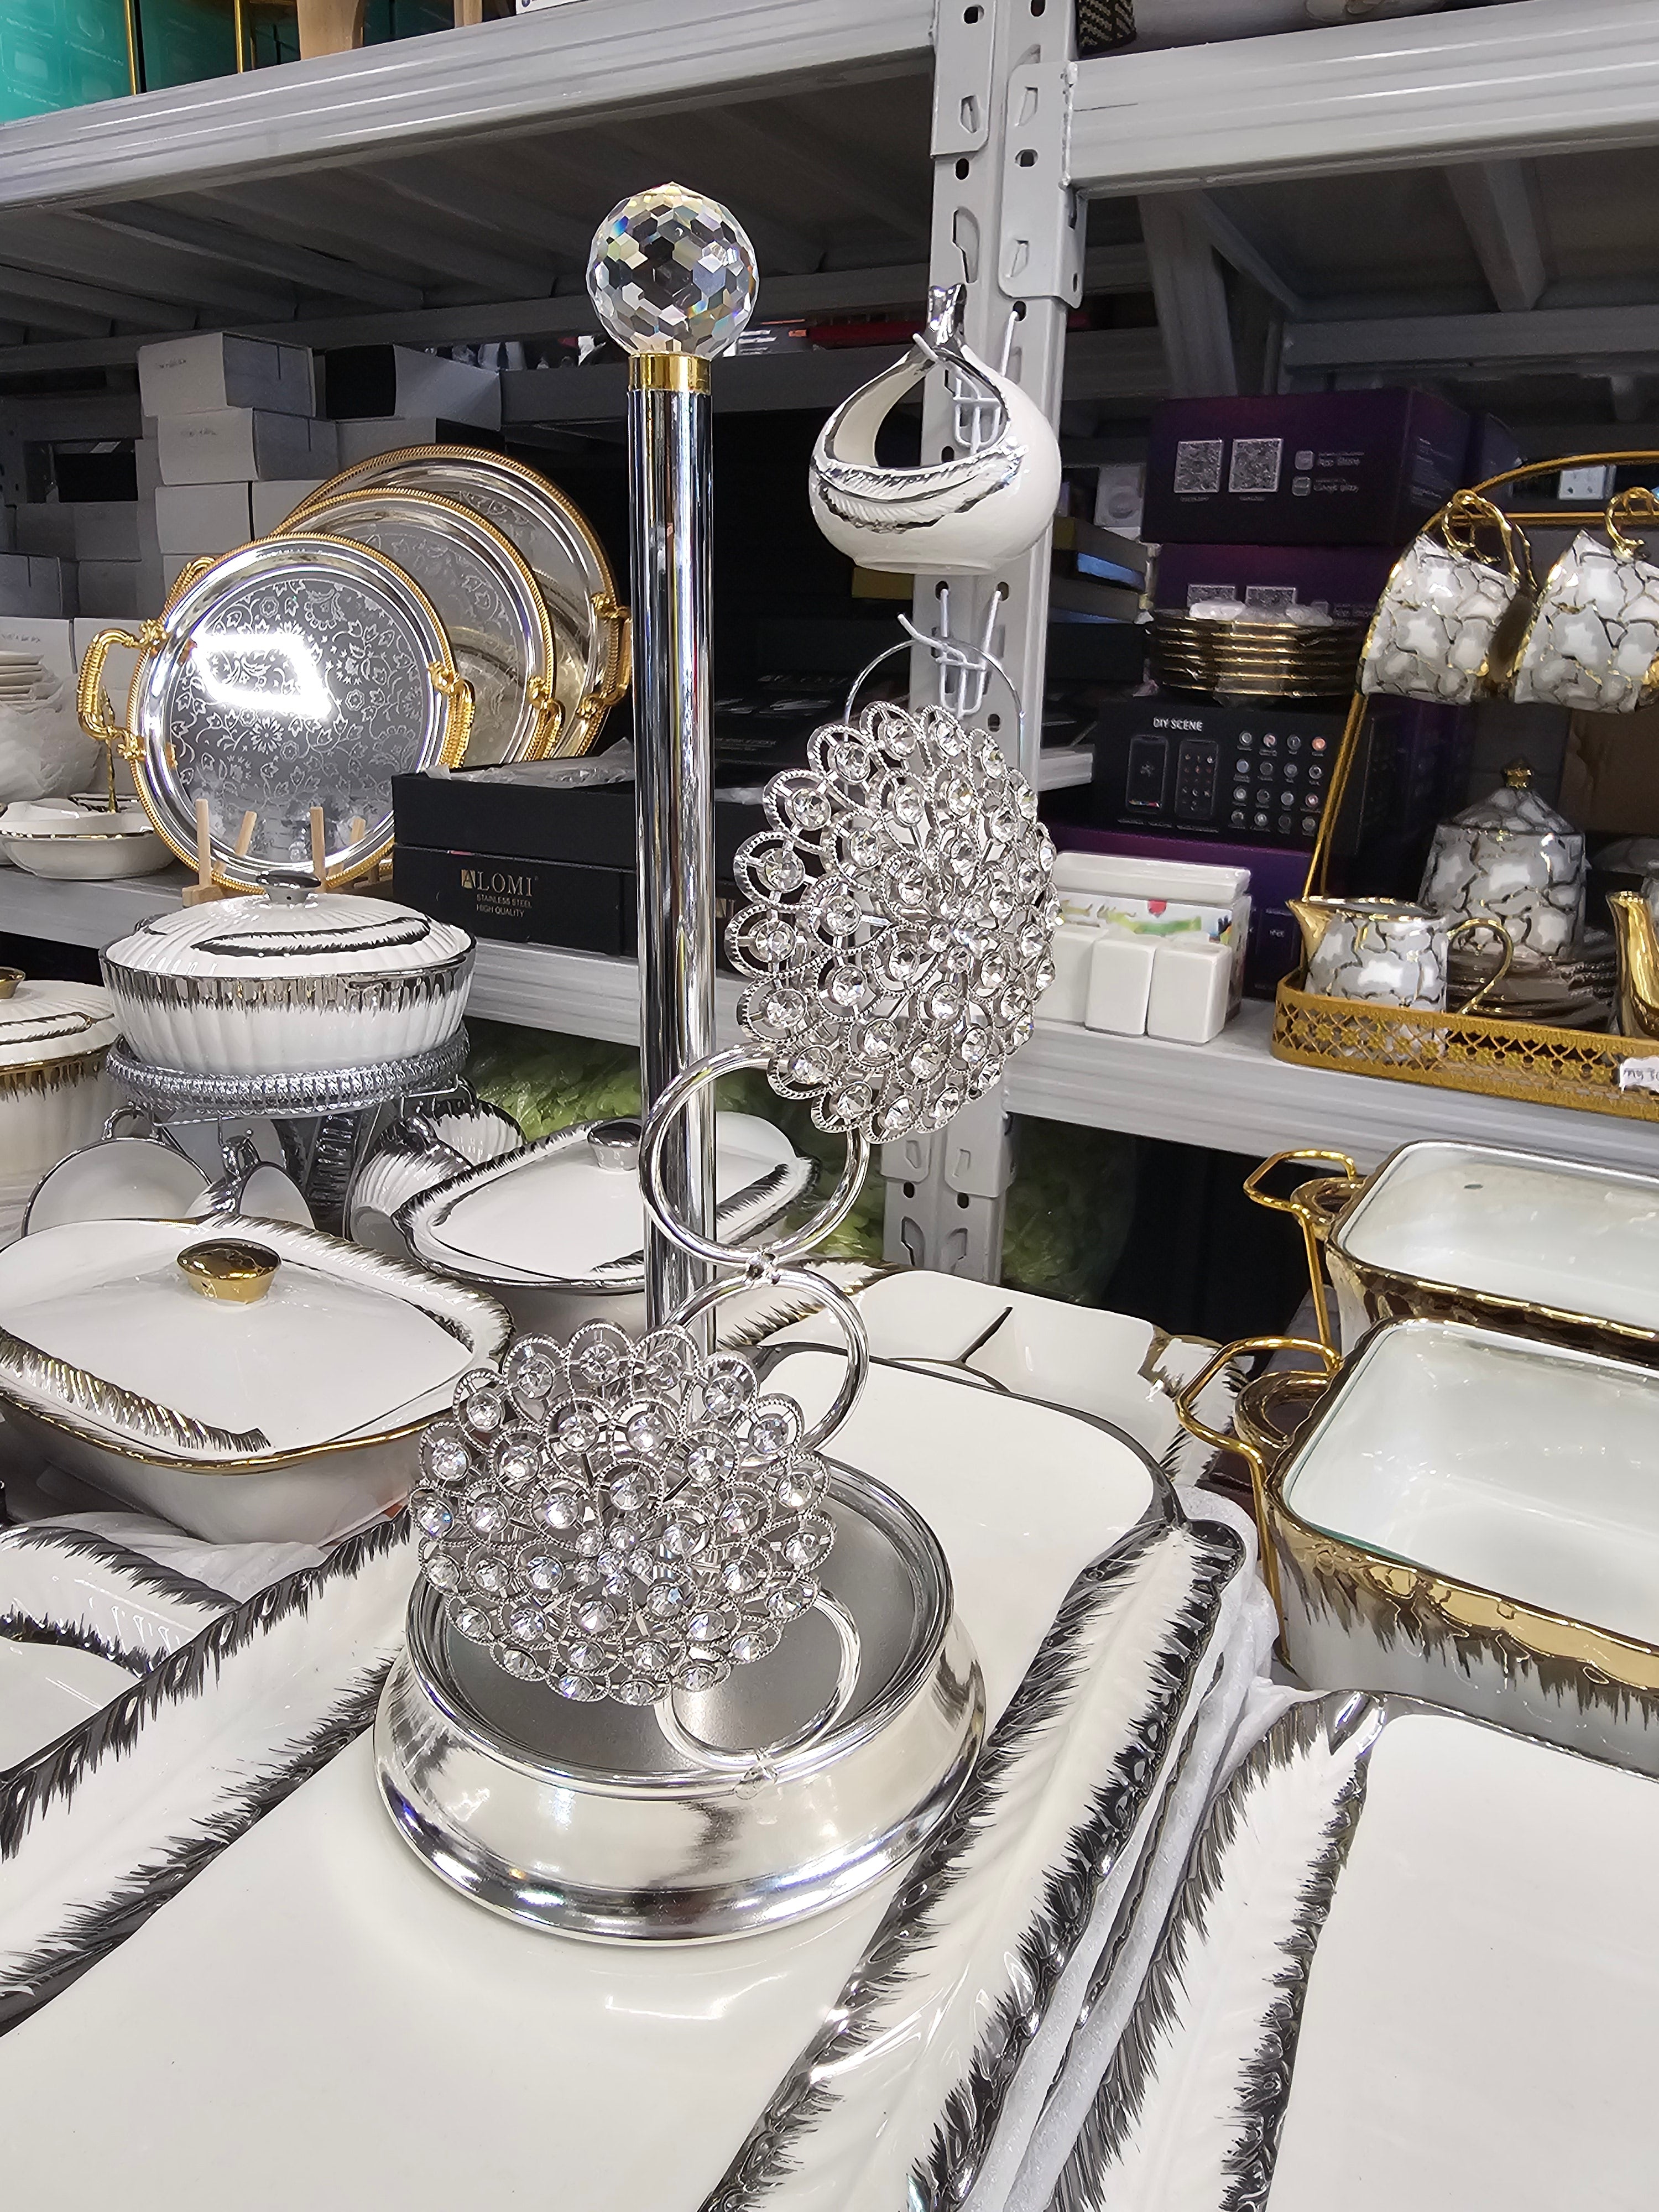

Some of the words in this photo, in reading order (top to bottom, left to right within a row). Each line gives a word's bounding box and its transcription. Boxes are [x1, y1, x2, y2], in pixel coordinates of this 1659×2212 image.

[1153, 717, 1169, 728] DIY
[1170, 718, 1203, 732] SCENE
[461, 869, 533, 897] ALOMI
[476, 894, 511, 905] STAINLESS
[512, 898, 532, 909] STEEL
[476, 904, 494, 914] HIGH
[494, 906, 525, 918] QUALITY
